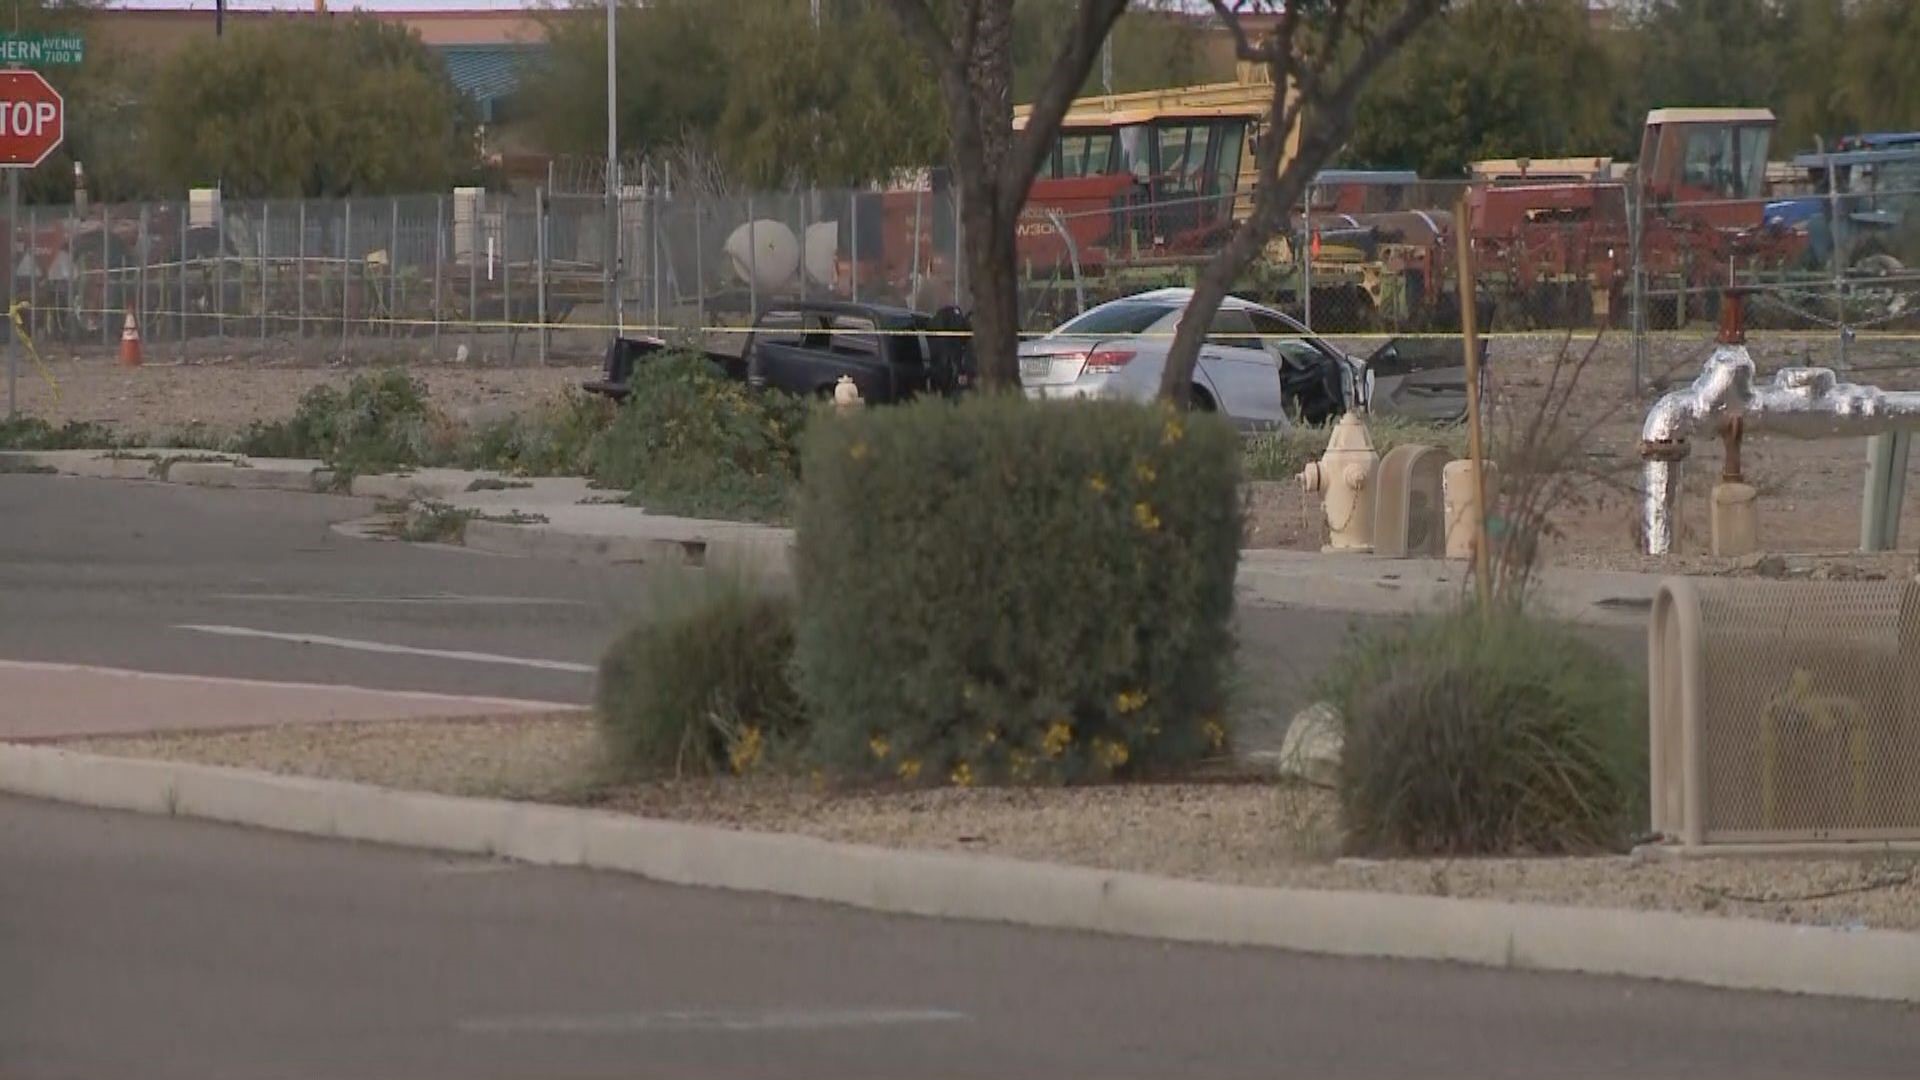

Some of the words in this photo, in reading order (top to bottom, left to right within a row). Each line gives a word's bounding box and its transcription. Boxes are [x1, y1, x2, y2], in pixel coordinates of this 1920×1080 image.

[0, 41, 40, 59] HERN
[42, 38, 81, 50] AVENUE
[45, 51, 70, 62] 7100
[74, 51, 82, 62] W
[0, 101, 56, 136] TOP
